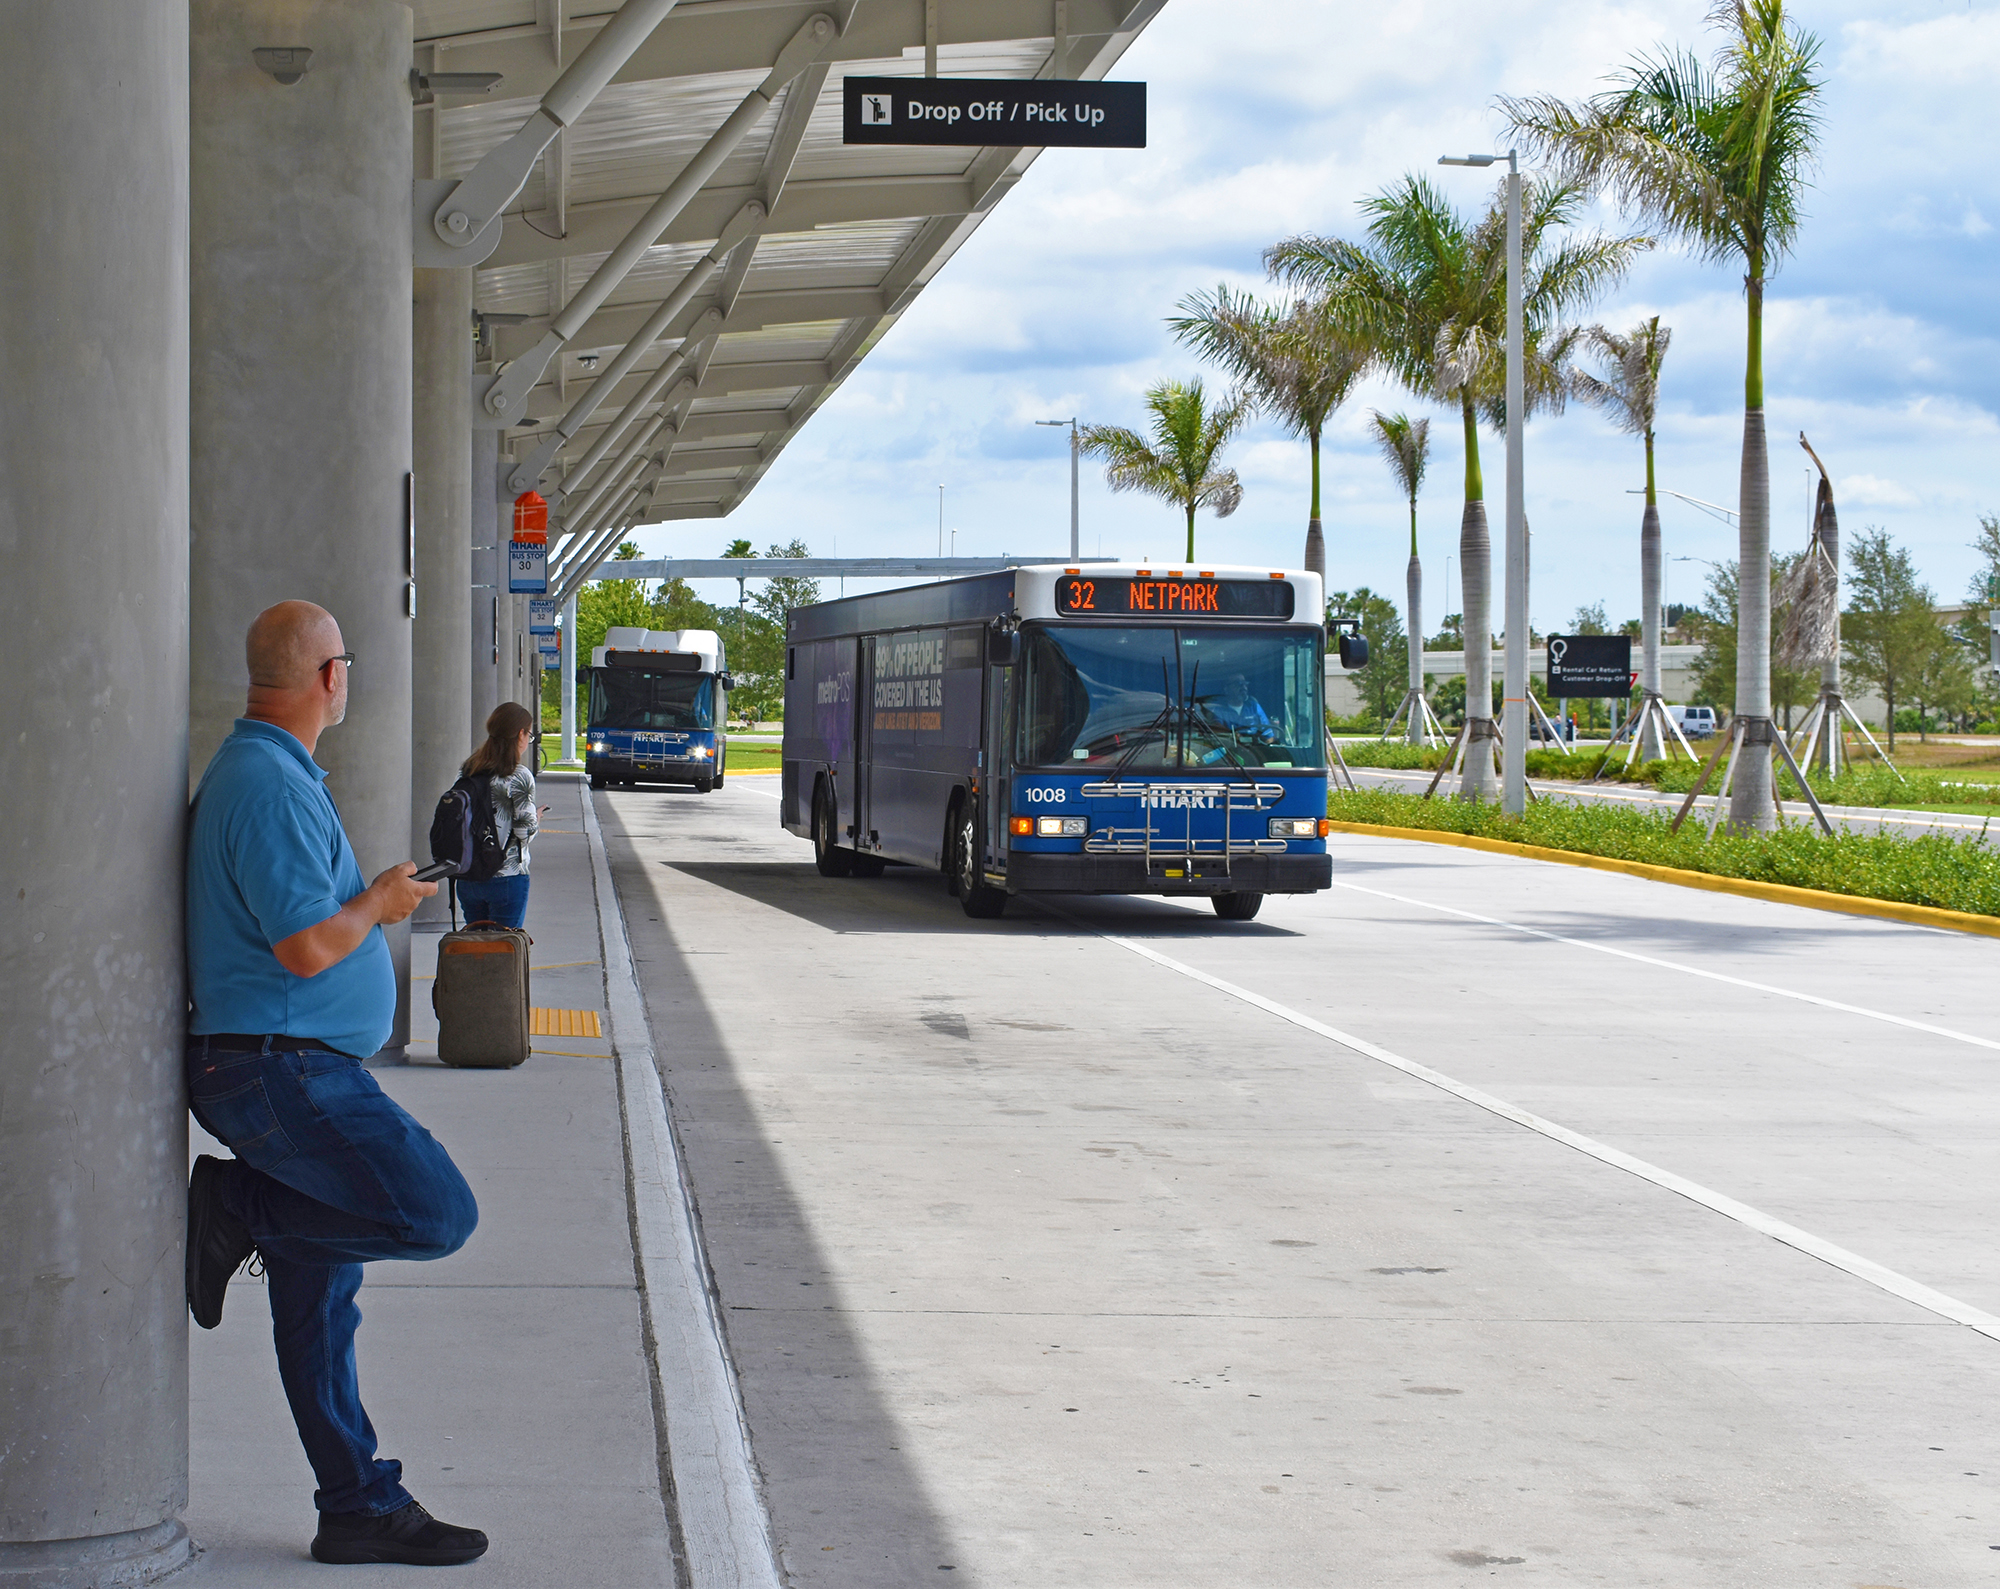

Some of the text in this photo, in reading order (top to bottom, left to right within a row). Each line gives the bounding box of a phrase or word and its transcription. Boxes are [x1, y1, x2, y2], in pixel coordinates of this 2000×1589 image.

[908, 101, 1106, 127] Drop Off / Pick Up
[518, 560, 532, 571] 30
[1069, 581, 1220, 611] 32 NETPARK
[875, 639, 944, 678] 99% OF PEOPLE
[1595, 675, 1626, 683] Drop-Off
[874, 681, 906, 708] COVERED
[906, 681, 914, 707] IN
[914, 679, 929, 707] THE
[1024, 787, 1067, 803] 1008
